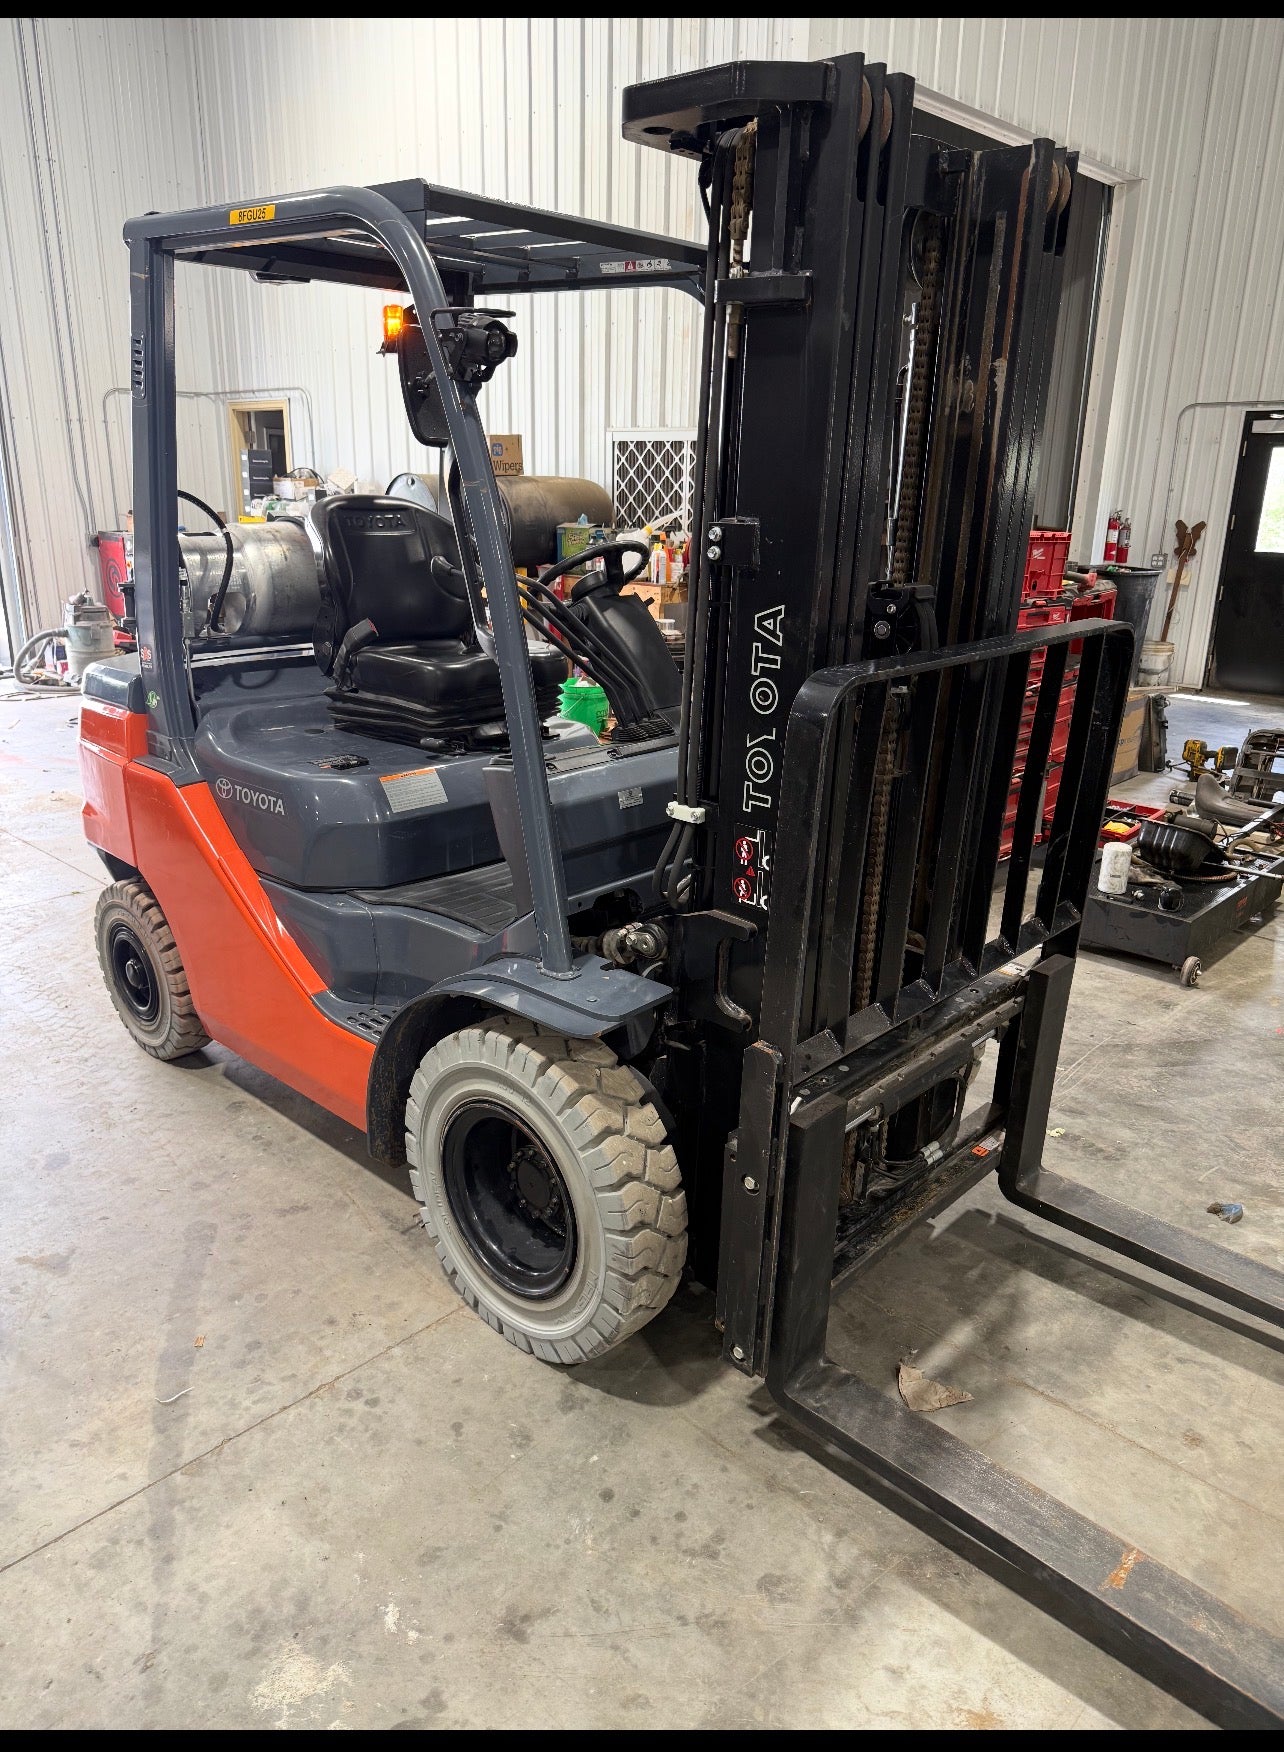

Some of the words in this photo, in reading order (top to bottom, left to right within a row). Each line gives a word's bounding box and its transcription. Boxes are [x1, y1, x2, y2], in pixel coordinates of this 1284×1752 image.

[238, 208, 266, 222] 8FGU25
[493, 460, 523, 473] Wipers
[344, 514, 406, 529] TOYOTA
[234, 784, 285, 816] TOYOTA
